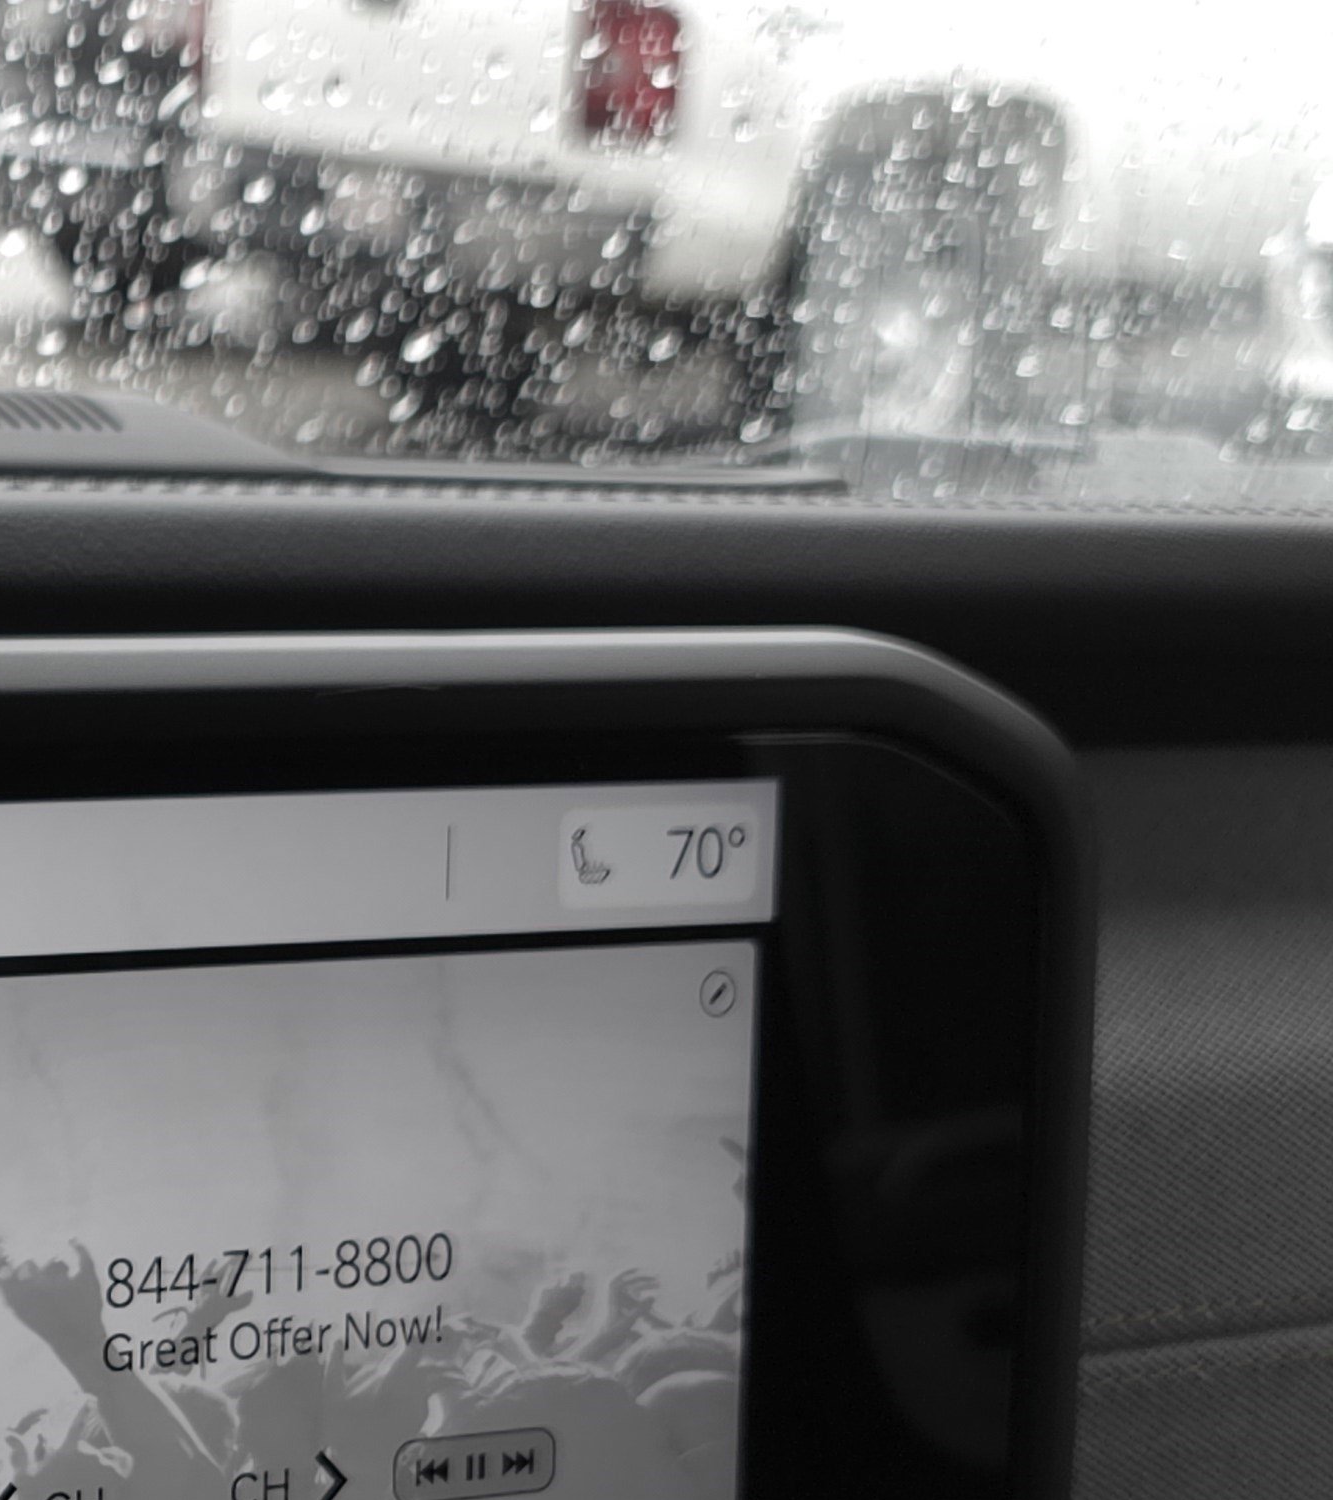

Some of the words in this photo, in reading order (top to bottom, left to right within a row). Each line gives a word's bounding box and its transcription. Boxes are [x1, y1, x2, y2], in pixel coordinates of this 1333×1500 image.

[667, 824, 748, 879] 70°
[105, 1232, 454, 1308] 844-711-8800
[102, 1326, 218, 1373] Great
[229, 1320, 334, 1361] Offer
[344, 1306, 444, 1352] Now!
